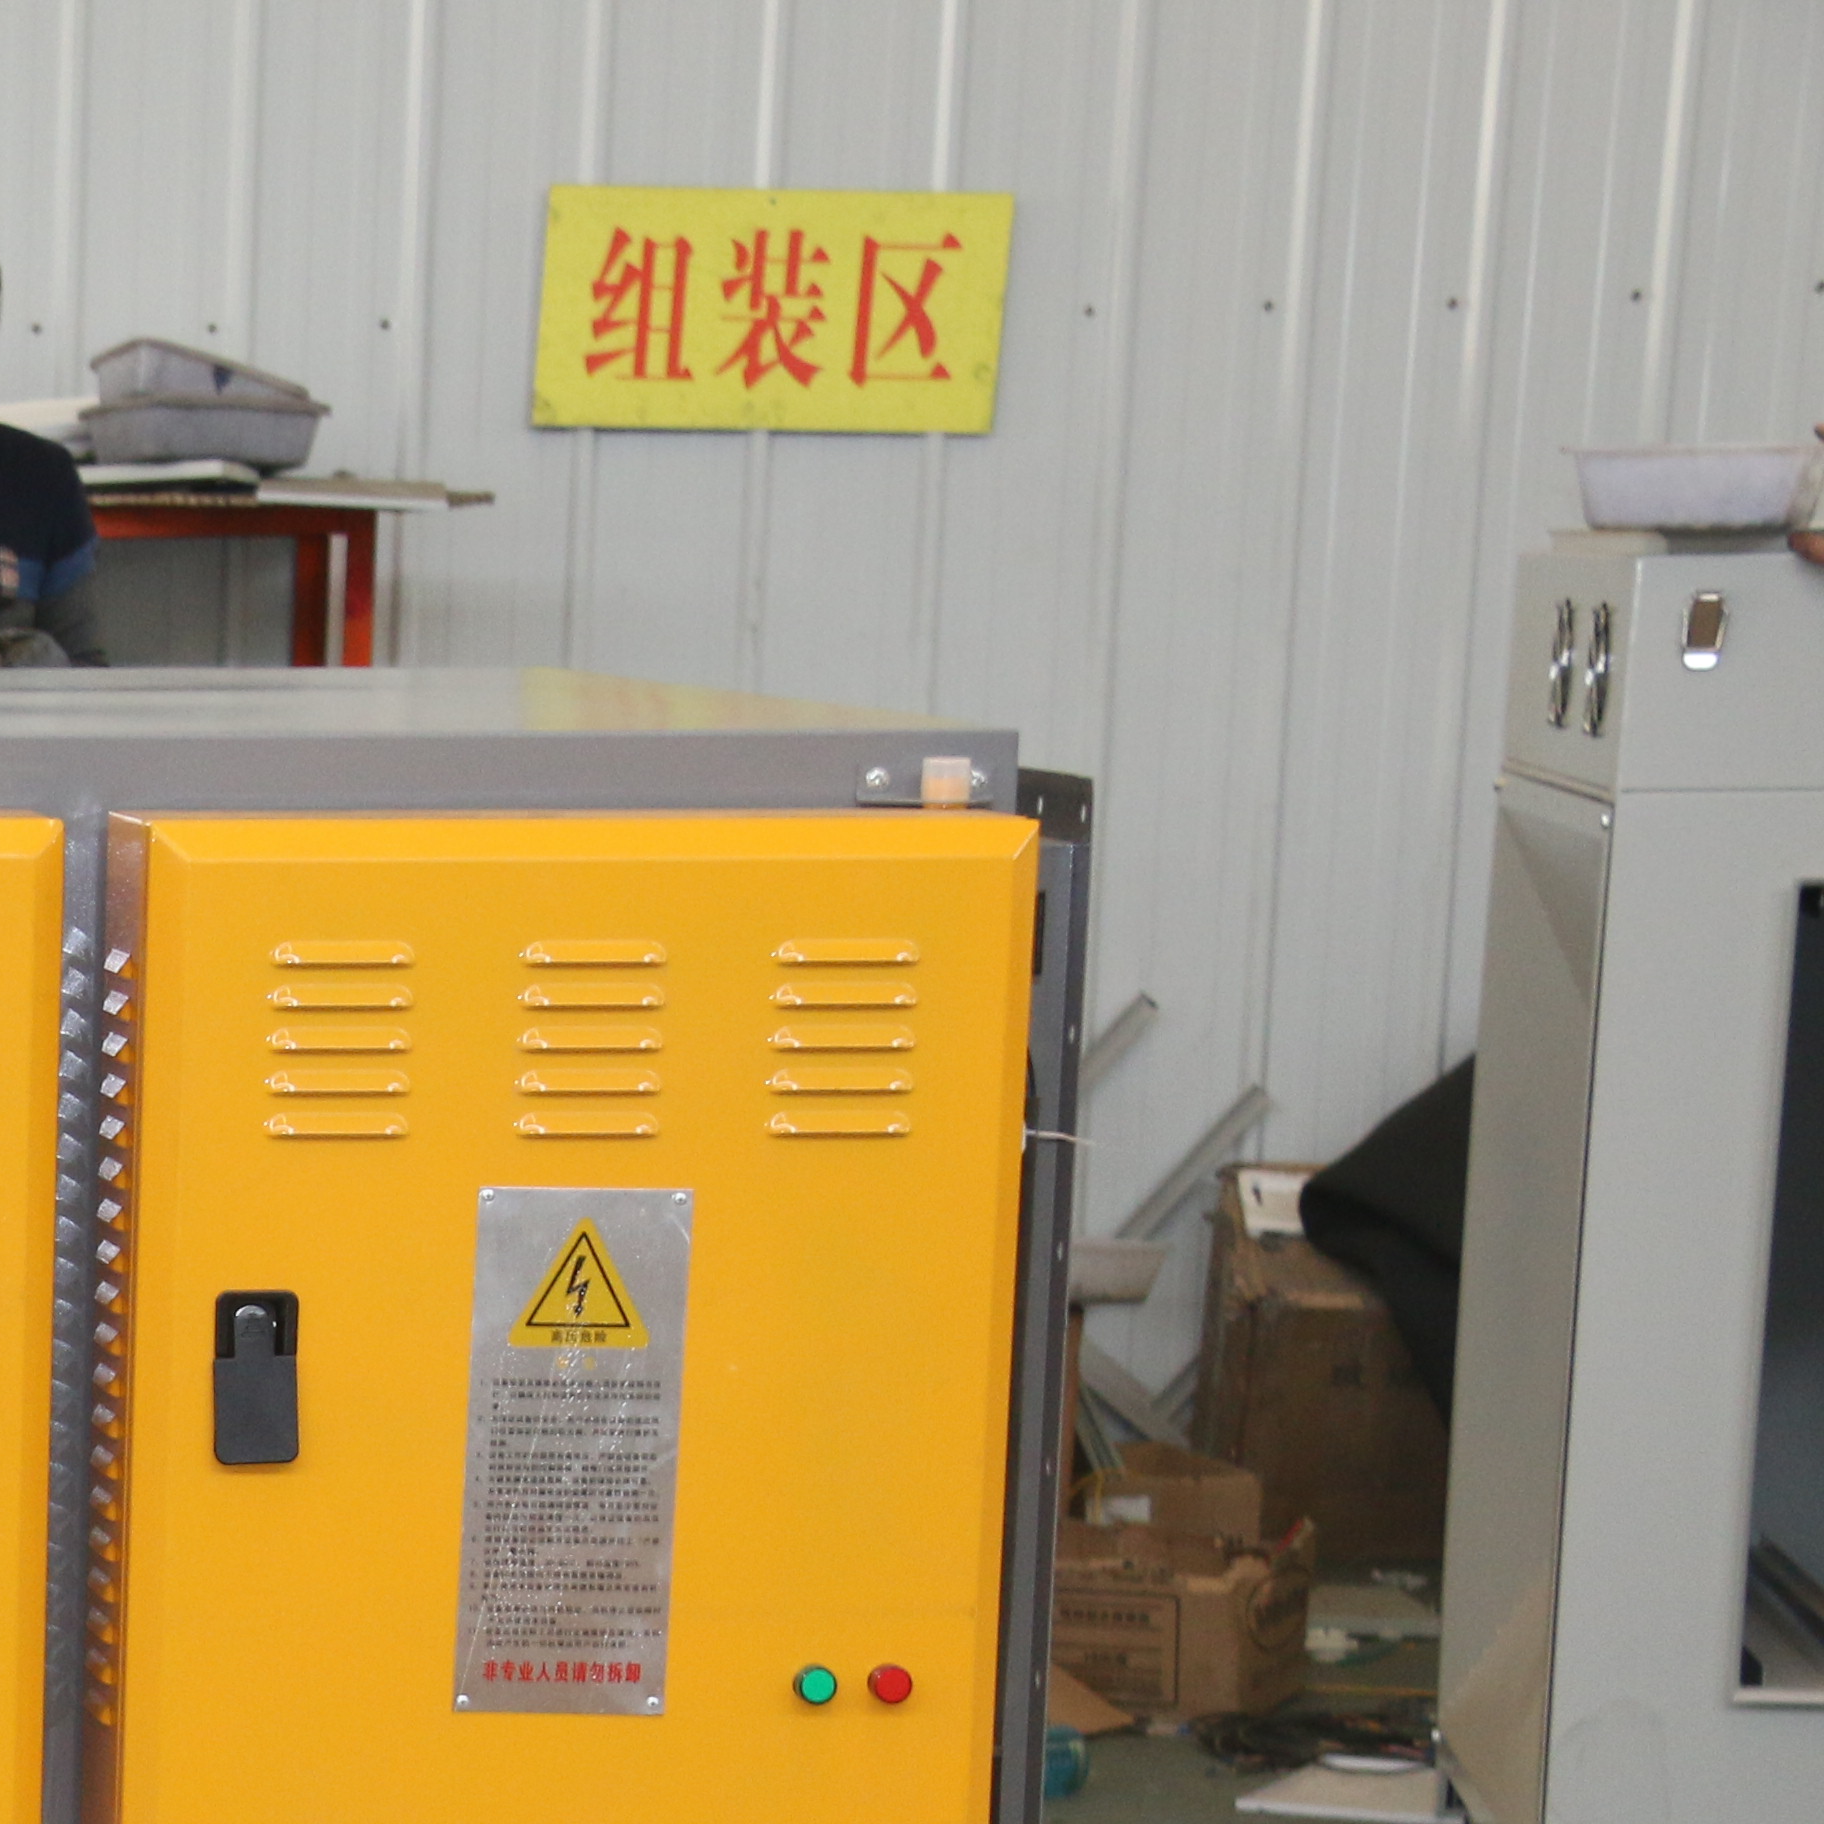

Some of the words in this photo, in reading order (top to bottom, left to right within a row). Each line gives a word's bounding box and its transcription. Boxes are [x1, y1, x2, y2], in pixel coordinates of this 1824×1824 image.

[584, 226, 962, 388] 组装区
[482, 1660, 643, 1683] 非专业人员请勿拆卸
